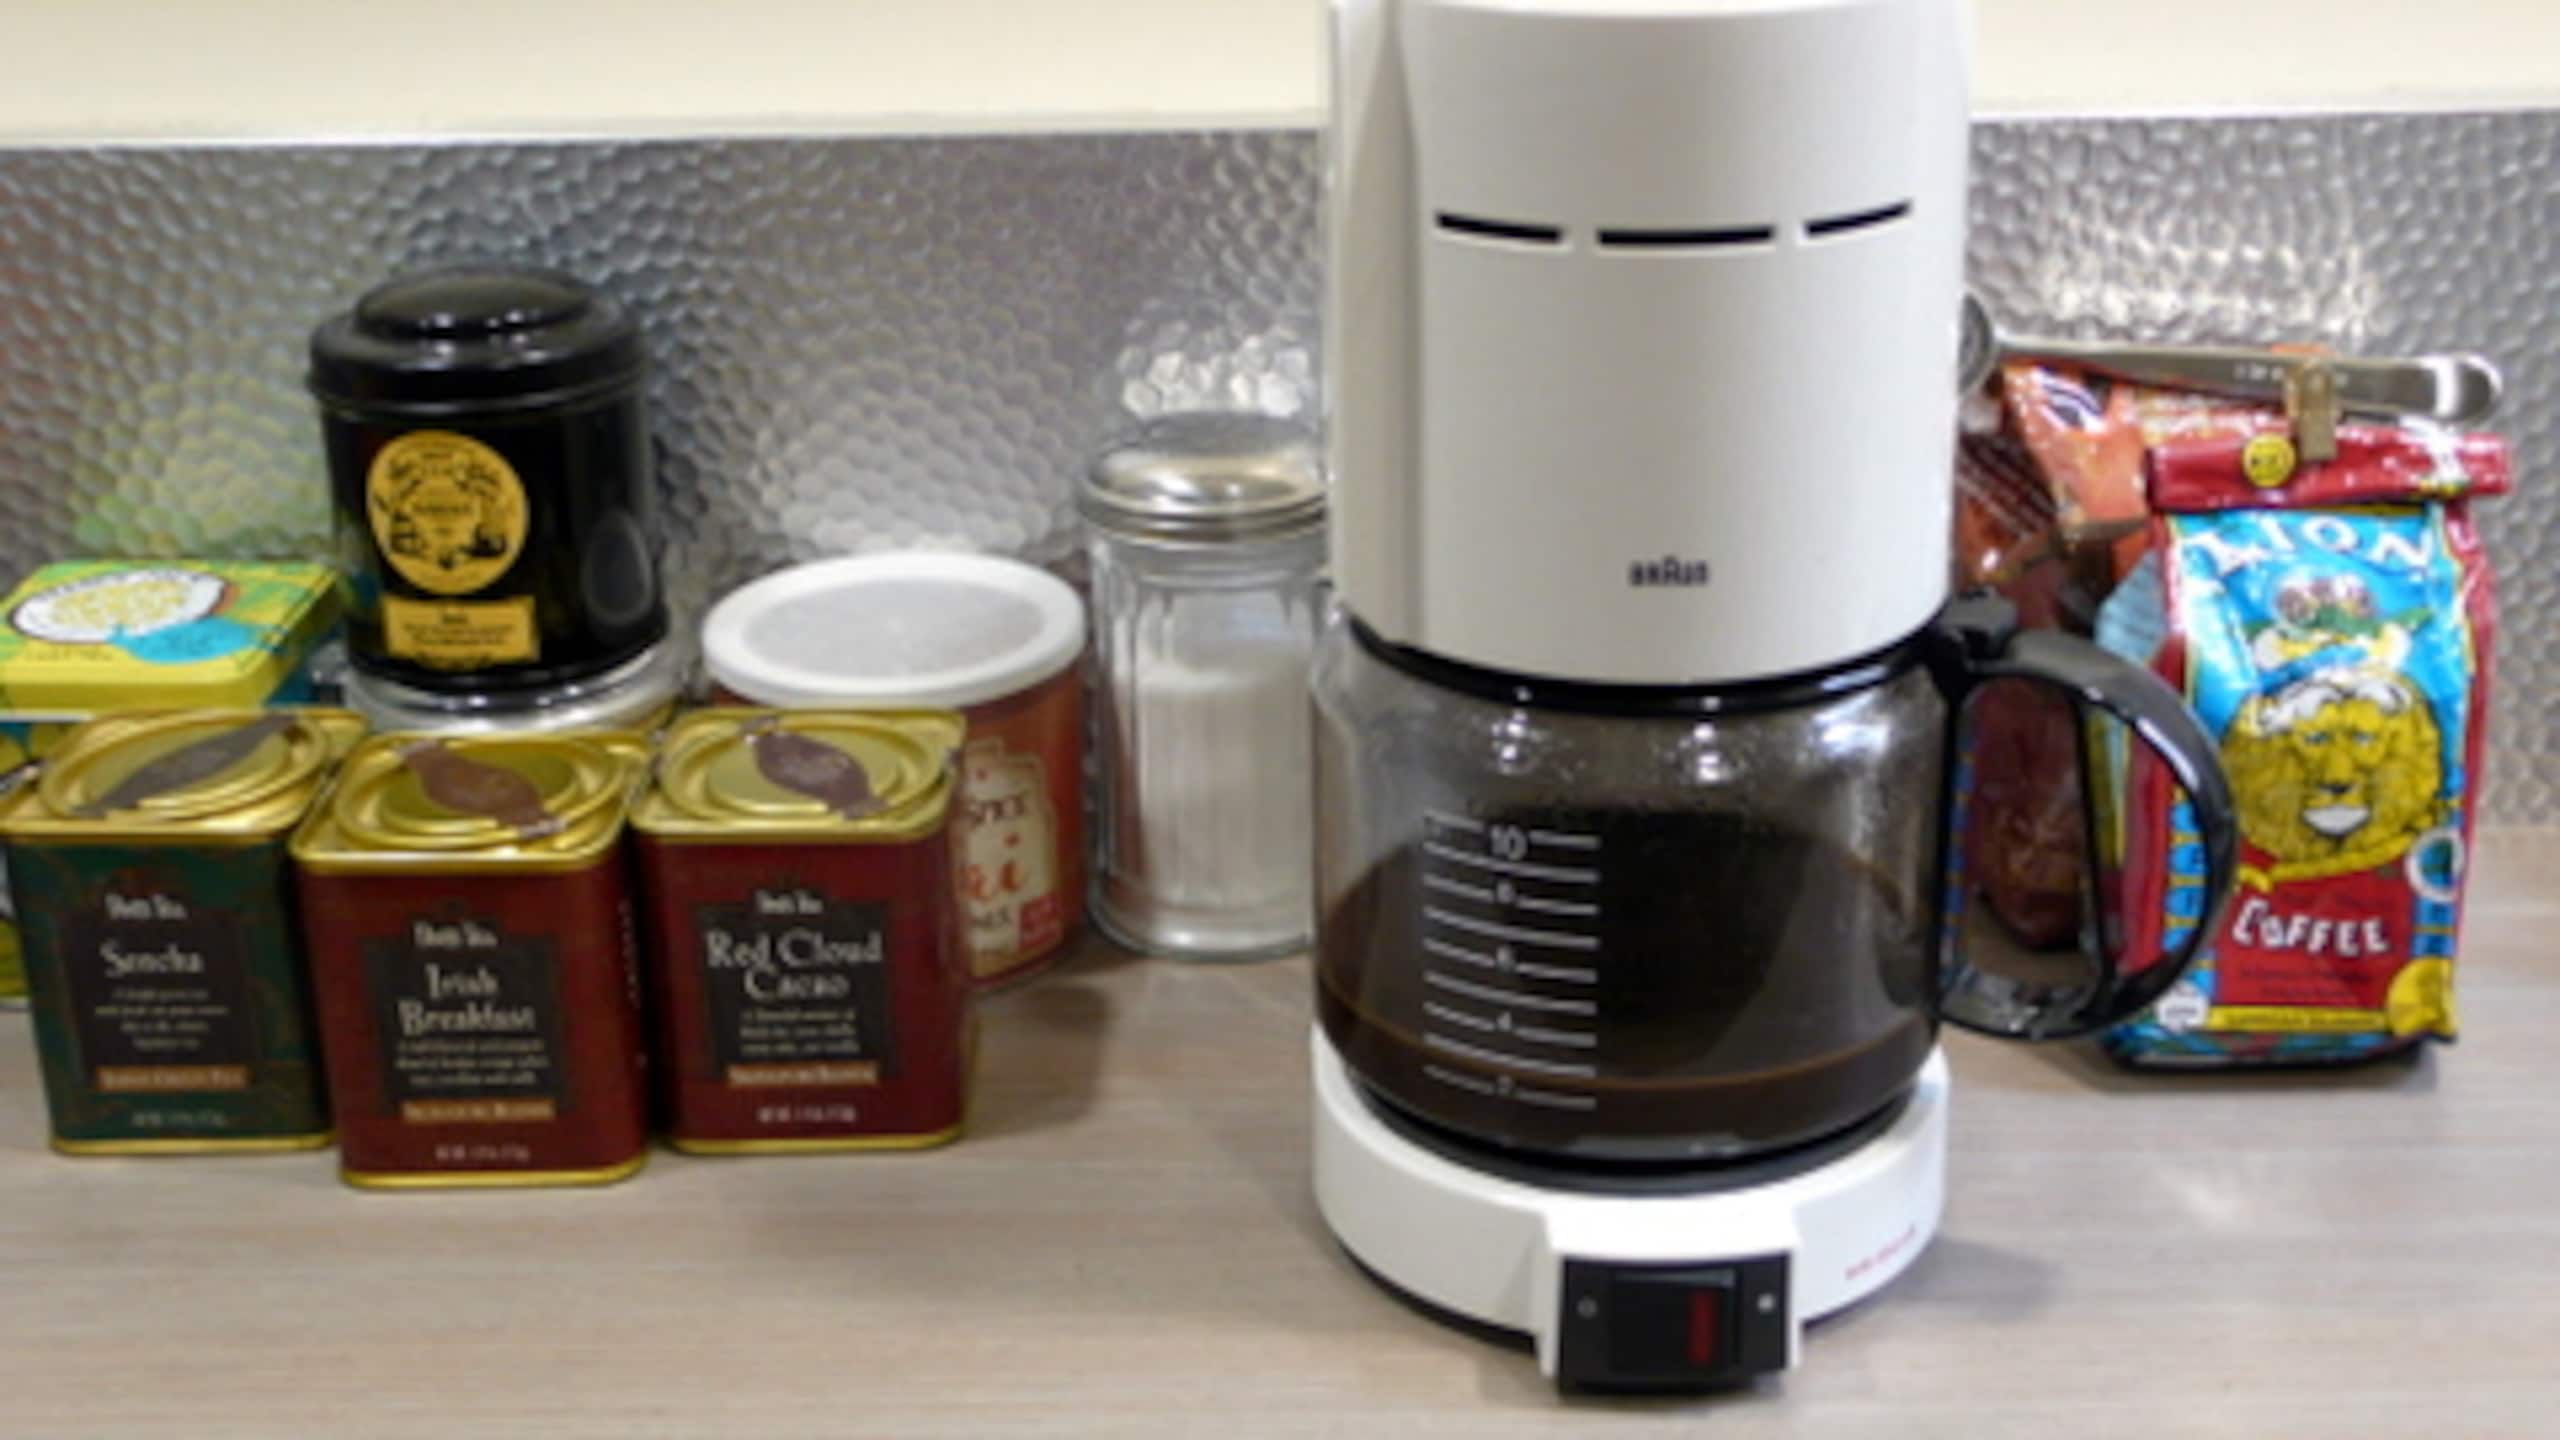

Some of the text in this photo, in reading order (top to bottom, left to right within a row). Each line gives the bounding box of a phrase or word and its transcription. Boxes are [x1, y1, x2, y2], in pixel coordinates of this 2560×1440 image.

[1627, 555, 1709, 588] BRAUN
[1489, 823, 1528, 861] 10
[2231, 896, 2391, 957] COFFEE
[100, 939, 205, 979] Sencha
[706, 926, 883, 968] Red Cloud
[424, 963, 498, 999] Irish
[744, 964, 851, 1000] Cacao
[397, 999, 536, 1037] Breakfast
